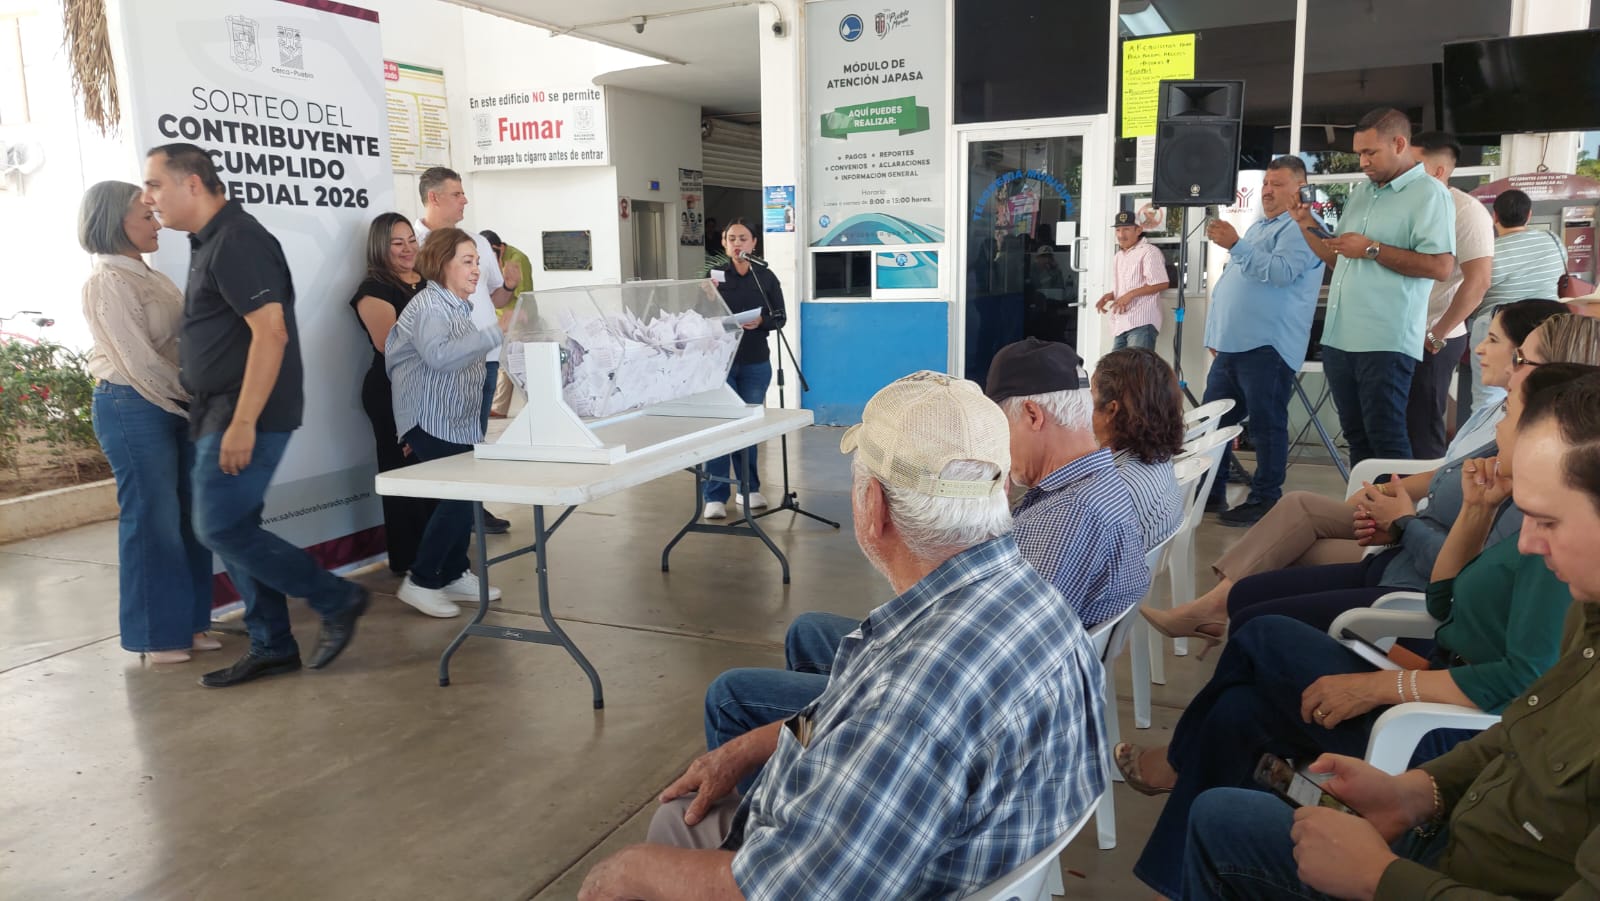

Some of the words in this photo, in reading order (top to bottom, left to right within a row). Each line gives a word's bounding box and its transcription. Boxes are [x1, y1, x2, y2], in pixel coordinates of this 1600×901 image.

[843, 61, 889, 74] MÓDULO
[891, 59, 905, 69] DE
[827, 73, 880, 89] ATENCIÓN
[881, 71, 924, 84] JAPASA
[192, 86, 299, 121] SORTEO
[307, 102, 353, 128] DEL
[469, 97, 479, 109] En
[481, 97, 497, 108] este
[498, 92, 530, 106] edificio
[532, 91, 546, 103] NO
[548, 91, 559, 102] se
[562, 88, 601, 104] permite
[848, 107, 869, 118] AQUÍ
[870, 105, 903, 116] PUEDES
[498, 117, 564, 142] Fumar
[854, 117, 897, 128] REALIZAR:
[157, 114, 381, 157] CONTRIBUYENTE
[473, 154, 483, 166] Por
[483, 153, 496, 165] favor
[497, 154, 515, 166] apaga
[515, 152, 523, 163] tu
[523, 151, 547, 164] cigarro
[548, 150, 568, 161] antes
[570, 149, 579, 160] de
[581, 149, 604, 161] entrar
[844, 153, 867, 161] PAGOS
[879, 149, 915, 158] REPORTES
[208, 149, 345, 181] CUMPLIDO
[830, 163, 868, 172] CONVENIOS
[878, 159, 931, 168] ACLARACIONES
[228, 180, 309, 206] EDIAL
[314, 186, 369, 208] 2026
